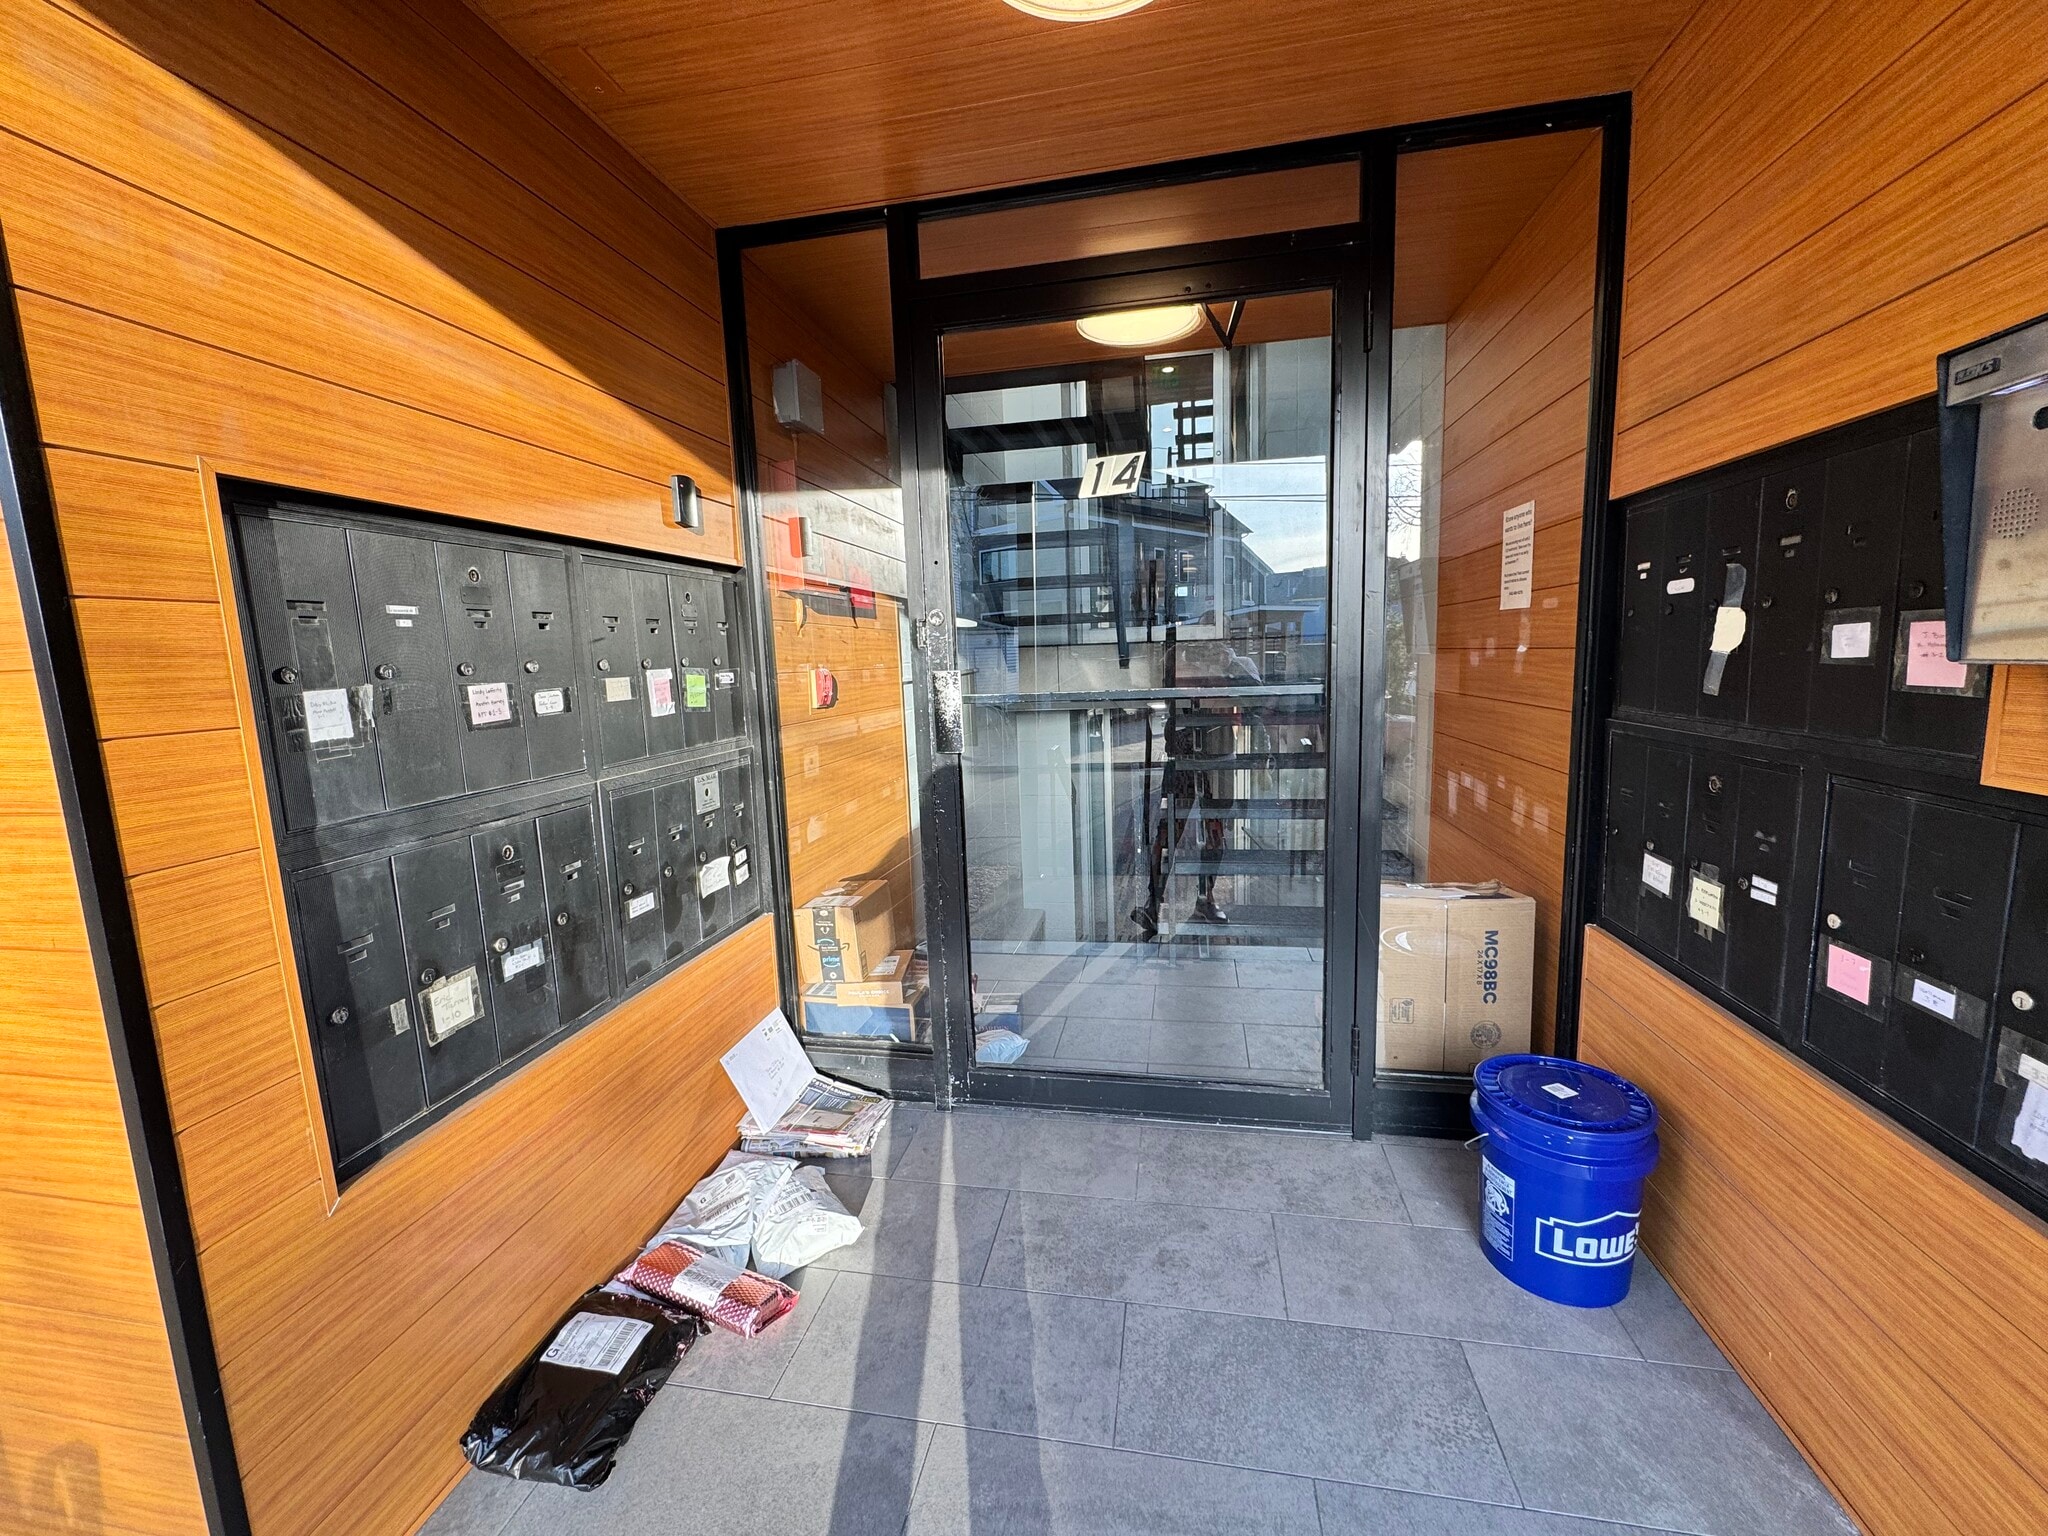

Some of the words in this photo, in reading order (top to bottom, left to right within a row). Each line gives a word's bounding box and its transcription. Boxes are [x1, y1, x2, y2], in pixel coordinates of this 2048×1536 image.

[1091, 455, 1141, 495] 14
[1477, 950, 1483, 959] 24
[822, 956, 840, 964] prime
[1483, 930, 1499, 1004] MC98BC
[545, 1348, 560, 1358] G
